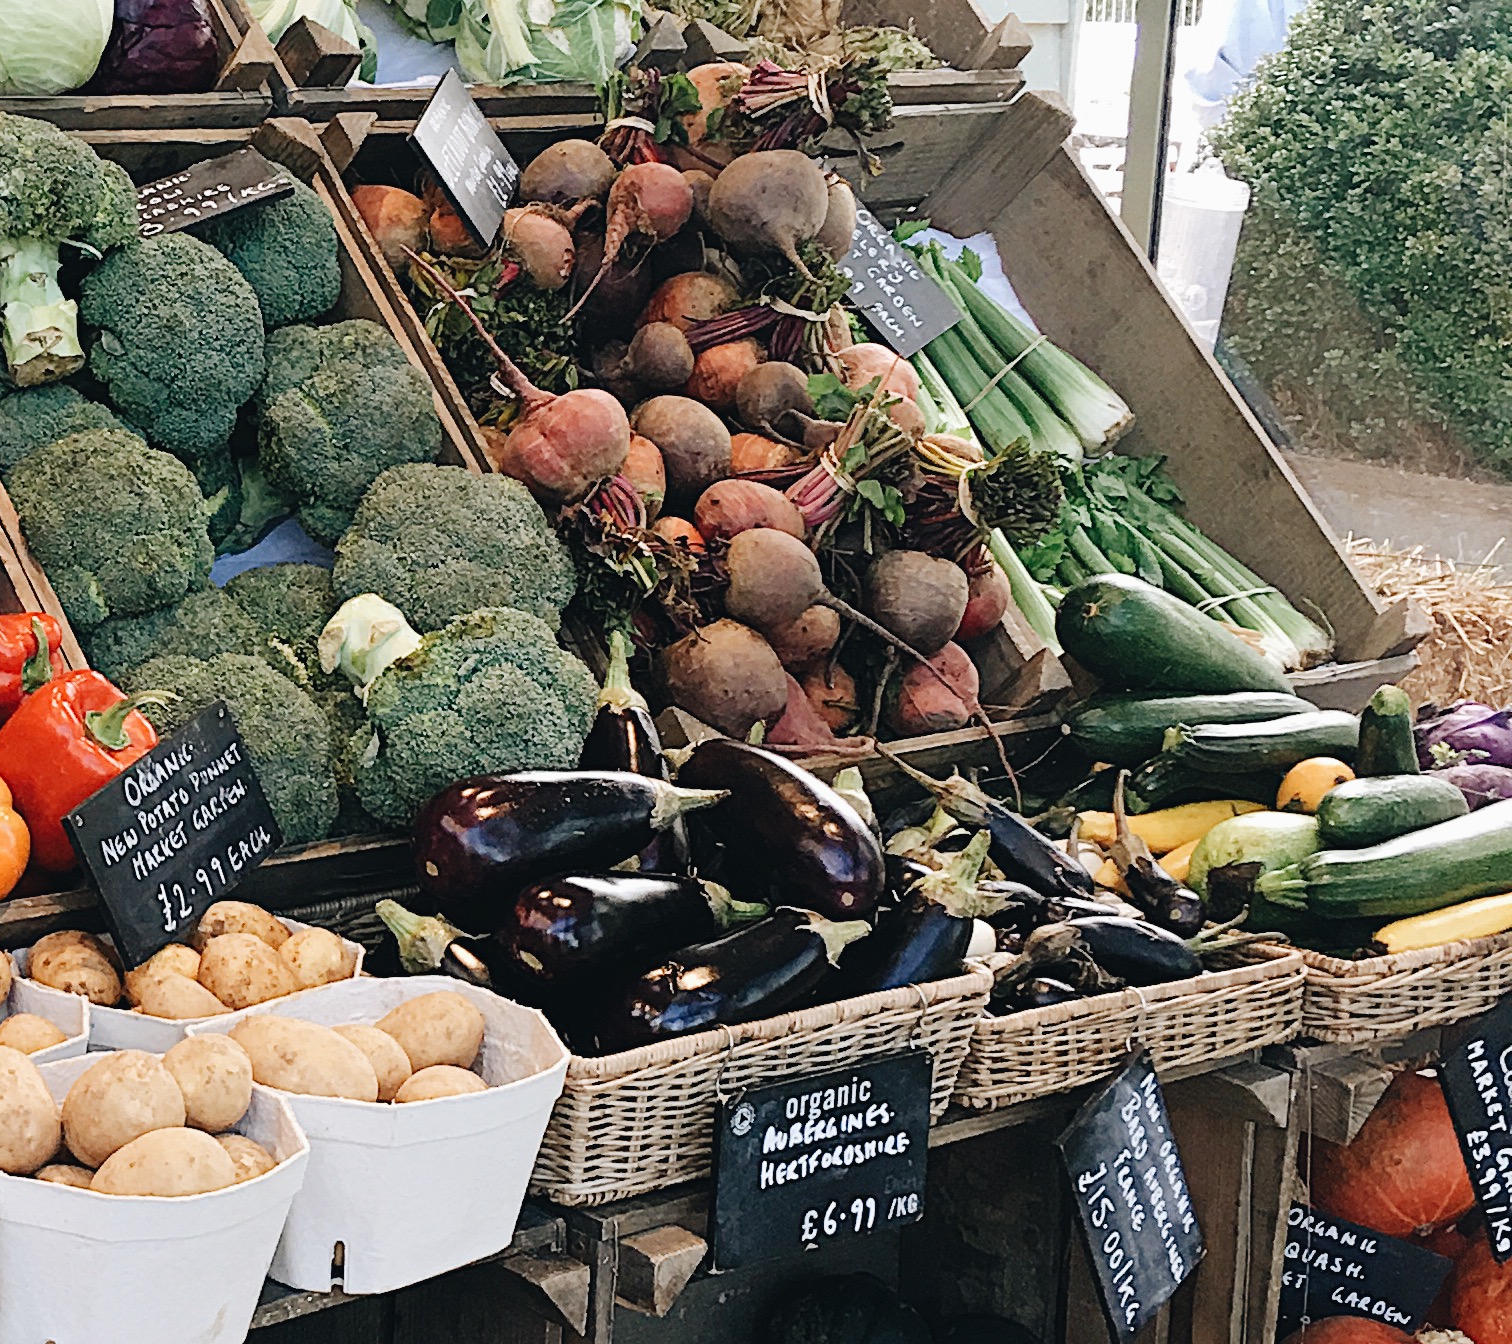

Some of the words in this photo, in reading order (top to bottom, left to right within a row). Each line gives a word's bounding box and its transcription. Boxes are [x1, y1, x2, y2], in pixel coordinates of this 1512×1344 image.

[852, 229, 904, 283] ELERY
[856, 209, 919, 280] ORGANIC
[867, 267, 923, 328] GARDEN
[101, 828, 138, 866] NEW
[138, 788, 189, 834] POTATO
[189, 742, 242, 792] PUNNET
[132, 821, 188, 880] MARKET
[158, 856, 226, 932] £2.99
[227, 826, 271, 872] EACH
[785, 1077, 872, 1120] organic
[1467, 1039, 1507, 1132] MARKET
[760, 1132, 910, 1189] HERTFORDSHIRE
[801, 1197, 876, 1241] £6.99
[1113, 1148, 1146, 1233] FRANCE
[1287, 1207, 1376, 1254] ORGANIC
[1284, 1242, 1365, 1280] QUASH.
[1331, 1286, 1412, 1325] GARDEN
